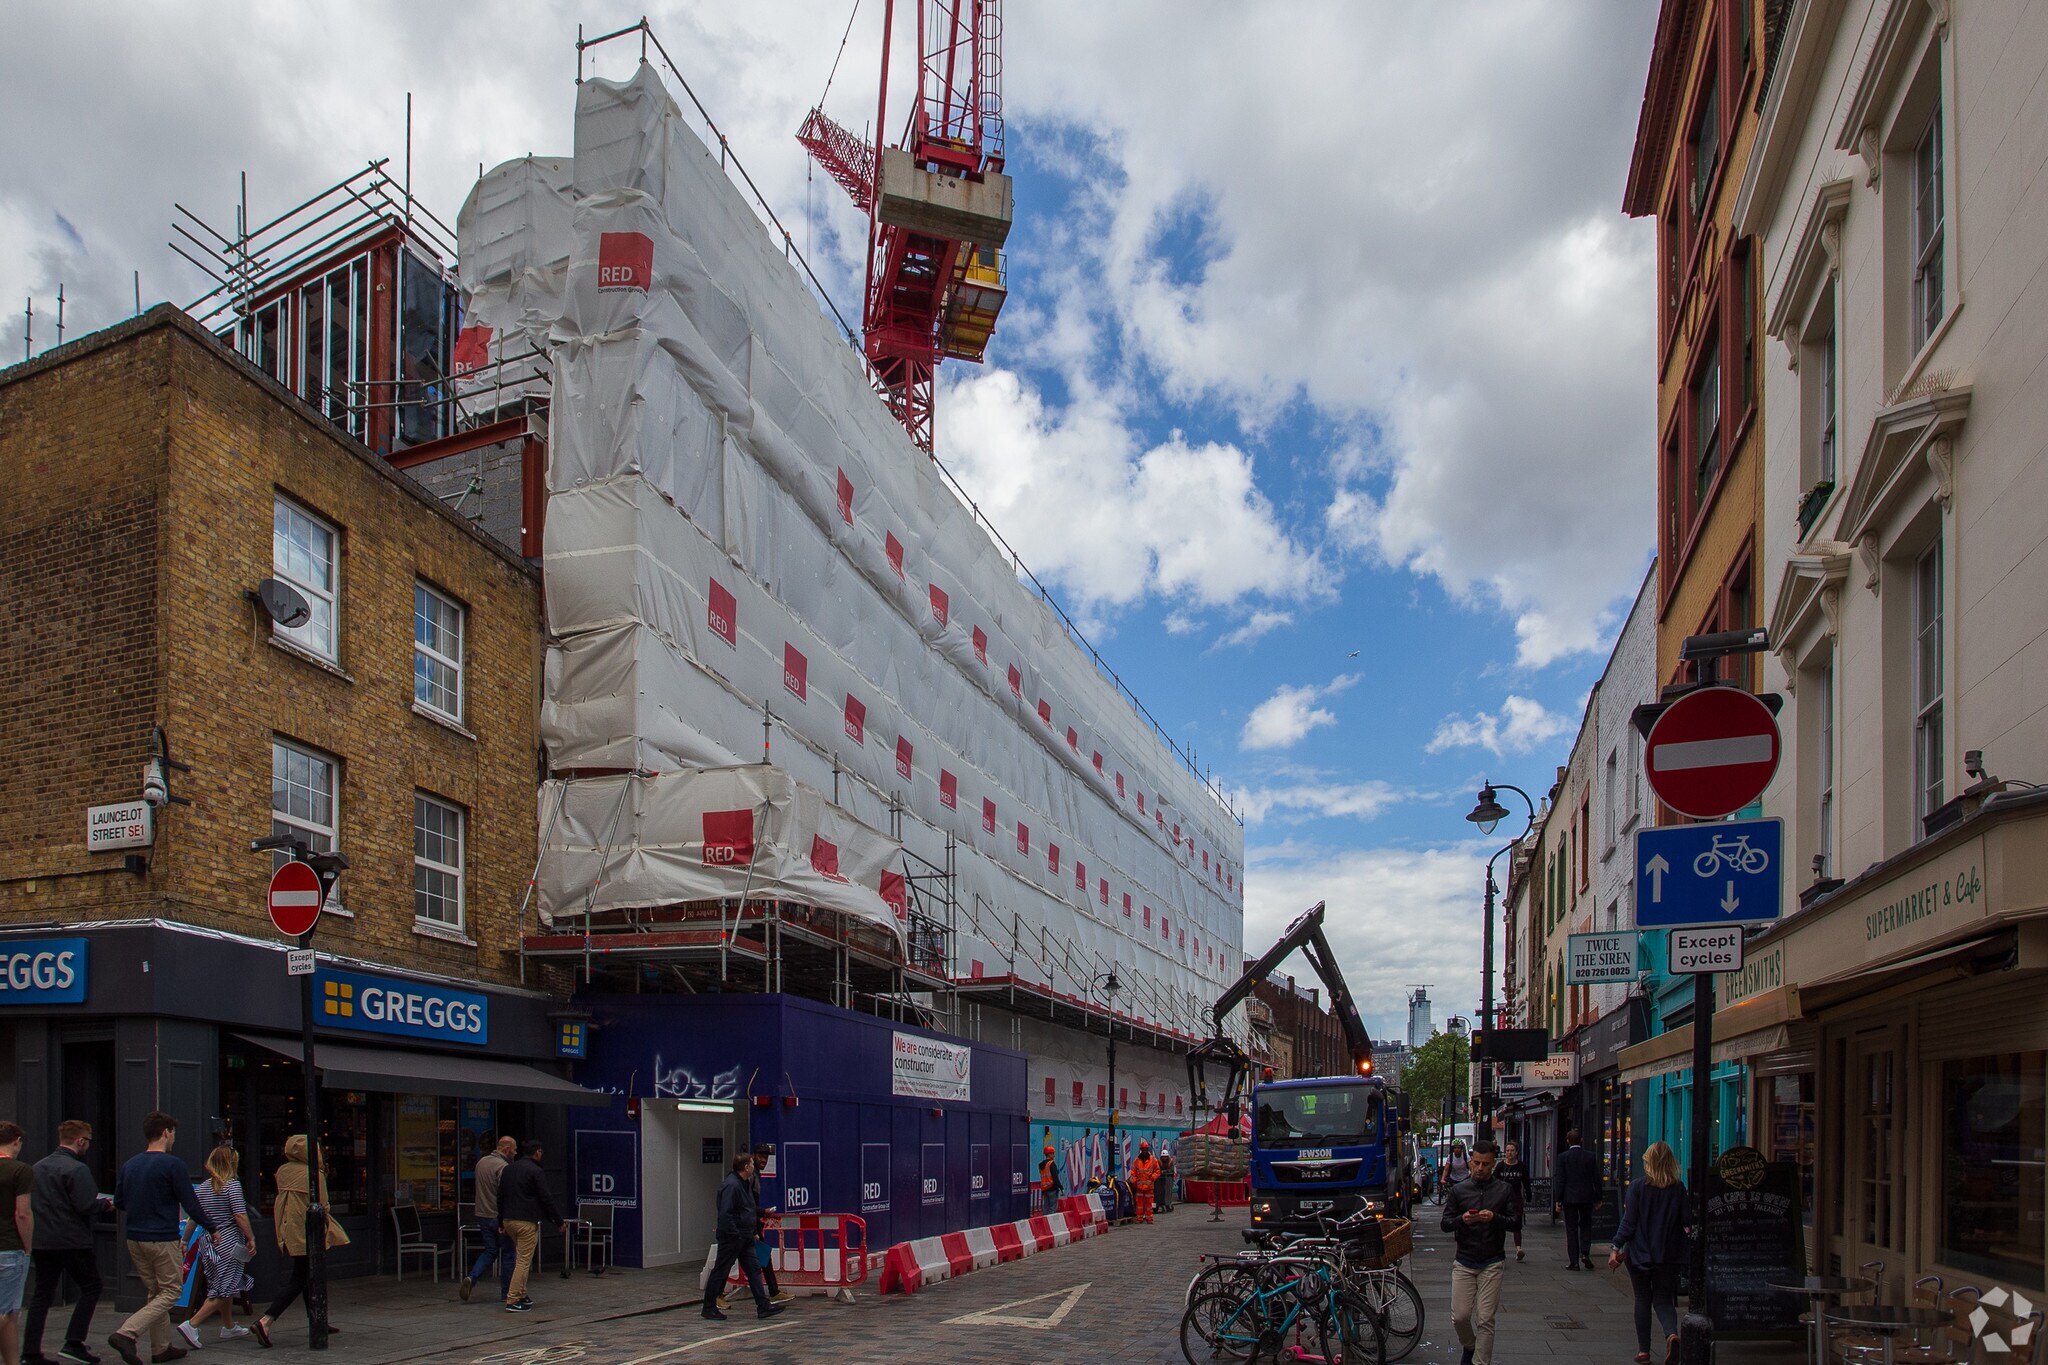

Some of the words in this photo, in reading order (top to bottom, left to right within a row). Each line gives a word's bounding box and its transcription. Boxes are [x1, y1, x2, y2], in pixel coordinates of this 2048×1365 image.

[601, 266, 633, 282] RED
[709, 611, 727, 634] RED
[785, 671, 800, 691] RED
[846, 719, 858, 737] RED
[897, 757, 908, 774] RED
[92, 808, 143, 825] LAUNCELOT
[92, 827, 126, 841] STREET
[128, 824, 145, 837] SE1
[705, 846, 735, 863] RED
[1866, 883, 1938, 941] SUPERMARKET
[1943, 881, 1951, 906] &
[1956, 865, 1982, 904] Cafe
[1585, 938, 1620, 952] TWICE
[1678, 934, 1735, 949] Except
[290, 953, 313, 962] Except
[1575, 953, 1597, 967] THE
[1598, 952, 1631, 966] SIREN
[1680, 951, 1732, 967] cycles
[291, 963, 311, 972] cycles
[1575, 968, 1591, 978] 020
[1592, 968, 1609, 977] 7261
[1610, 966, 1631, 976] 0025
[360, 988, 482, 1033] GREGGS
[894, 1036, 905, 1053] We
[907, 1042, 917, 1055] are
[917, 1045, 952, 1061] considerate
[894, 1057, 935, 1074] constructors
[1552, 1068, 1569, 1077] Cha
[1297, 1149, 1332, 1158] JEWSON
[1301, 1170, 1331, 1178] MAN
[1719, 1160, 1766, 1178] GREENSMITHS
[592, 1173, 615, 1193] ED
[924, 1178, 938, 1194] RED
[973, 1175, 984, 1190] RED
[1013, 1173, 1023, 1185] RED
[787, 1187, 809, 1207] RED
[864, 1182, 881, 1200] RED
[1723, 1191, 1746, 1202] CAFE
[1750, 1191, 1761, 1201] IS
[1754, 1204, 1785, 1216] TAKEAWAY
